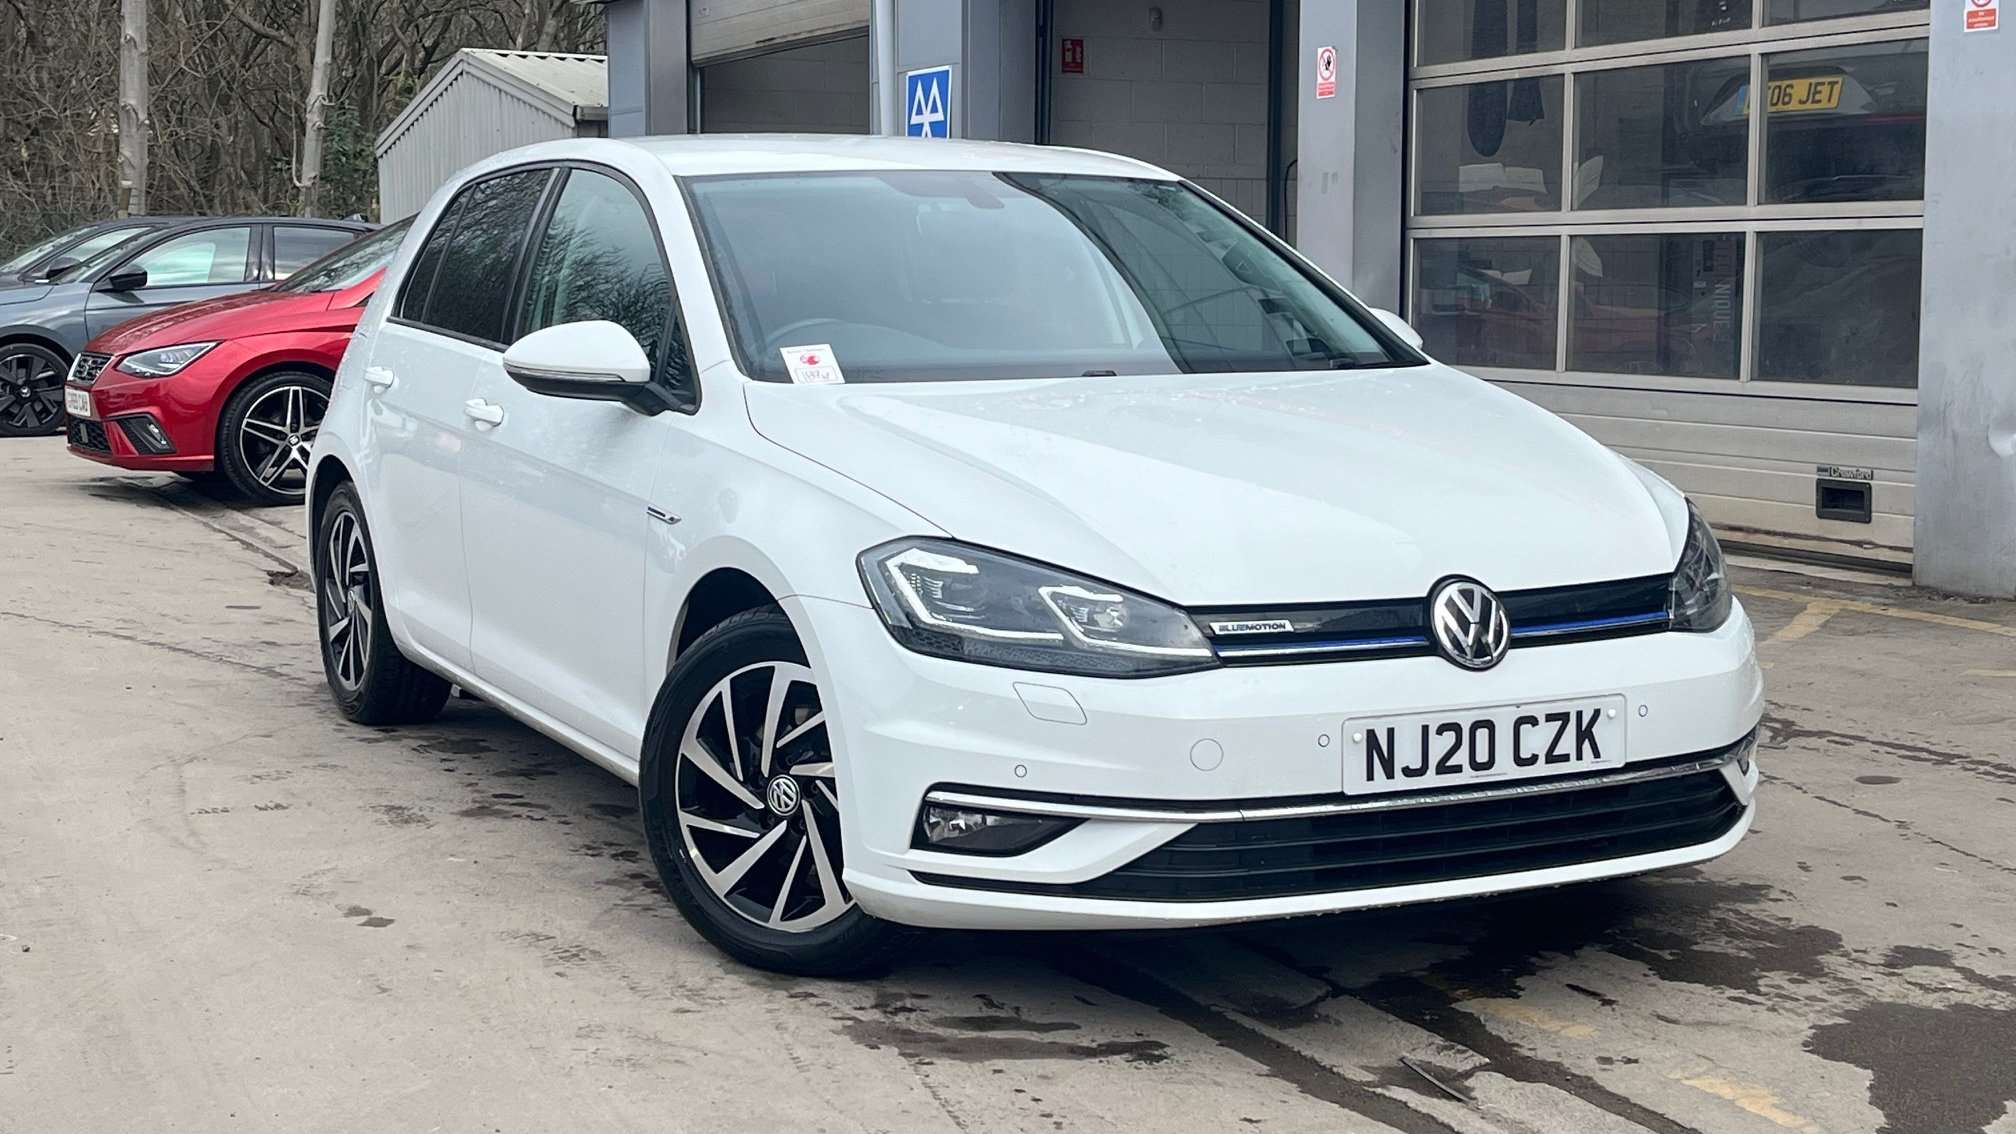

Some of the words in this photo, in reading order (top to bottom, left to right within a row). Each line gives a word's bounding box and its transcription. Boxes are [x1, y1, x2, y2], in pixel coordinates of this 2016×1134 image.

[1798, 80, 1840, 105] JET
[1218, 622, 1287, 632] BLUEMOTION
[1366, 718, 1496, 782] NJ20
[1513, 708, 1601, 767] CZK
